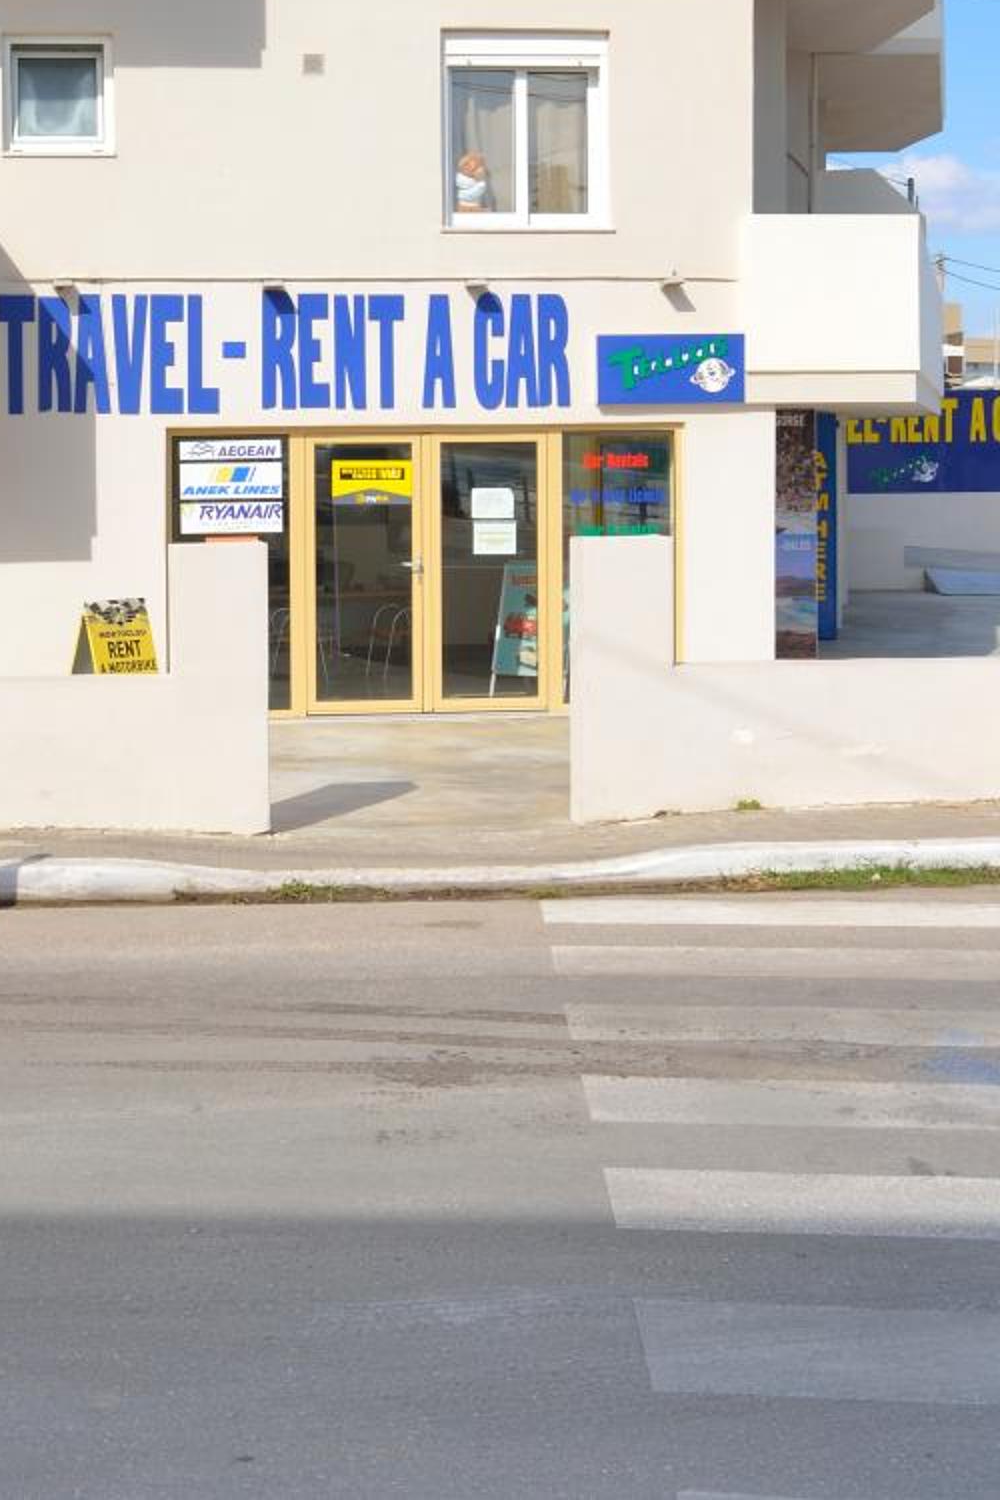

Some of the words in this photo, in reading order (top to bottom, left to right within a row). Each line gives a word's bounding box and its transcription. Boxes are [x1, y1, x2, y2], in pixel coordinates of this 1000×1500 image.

[261, 292, 405, 410] RENT
[422, 293, 457, 409] A
[473, 291, 571, 410] CAR
[969, 397, 987, 443] A
[217, 445, 277, 457] AEGEAN
[183, 485, 230, 496] ANEK
[233, 485, 280, 495] LINES
[199, 503, 283, 520] RYANAIR
[107, 638, 142, 660] RENT
